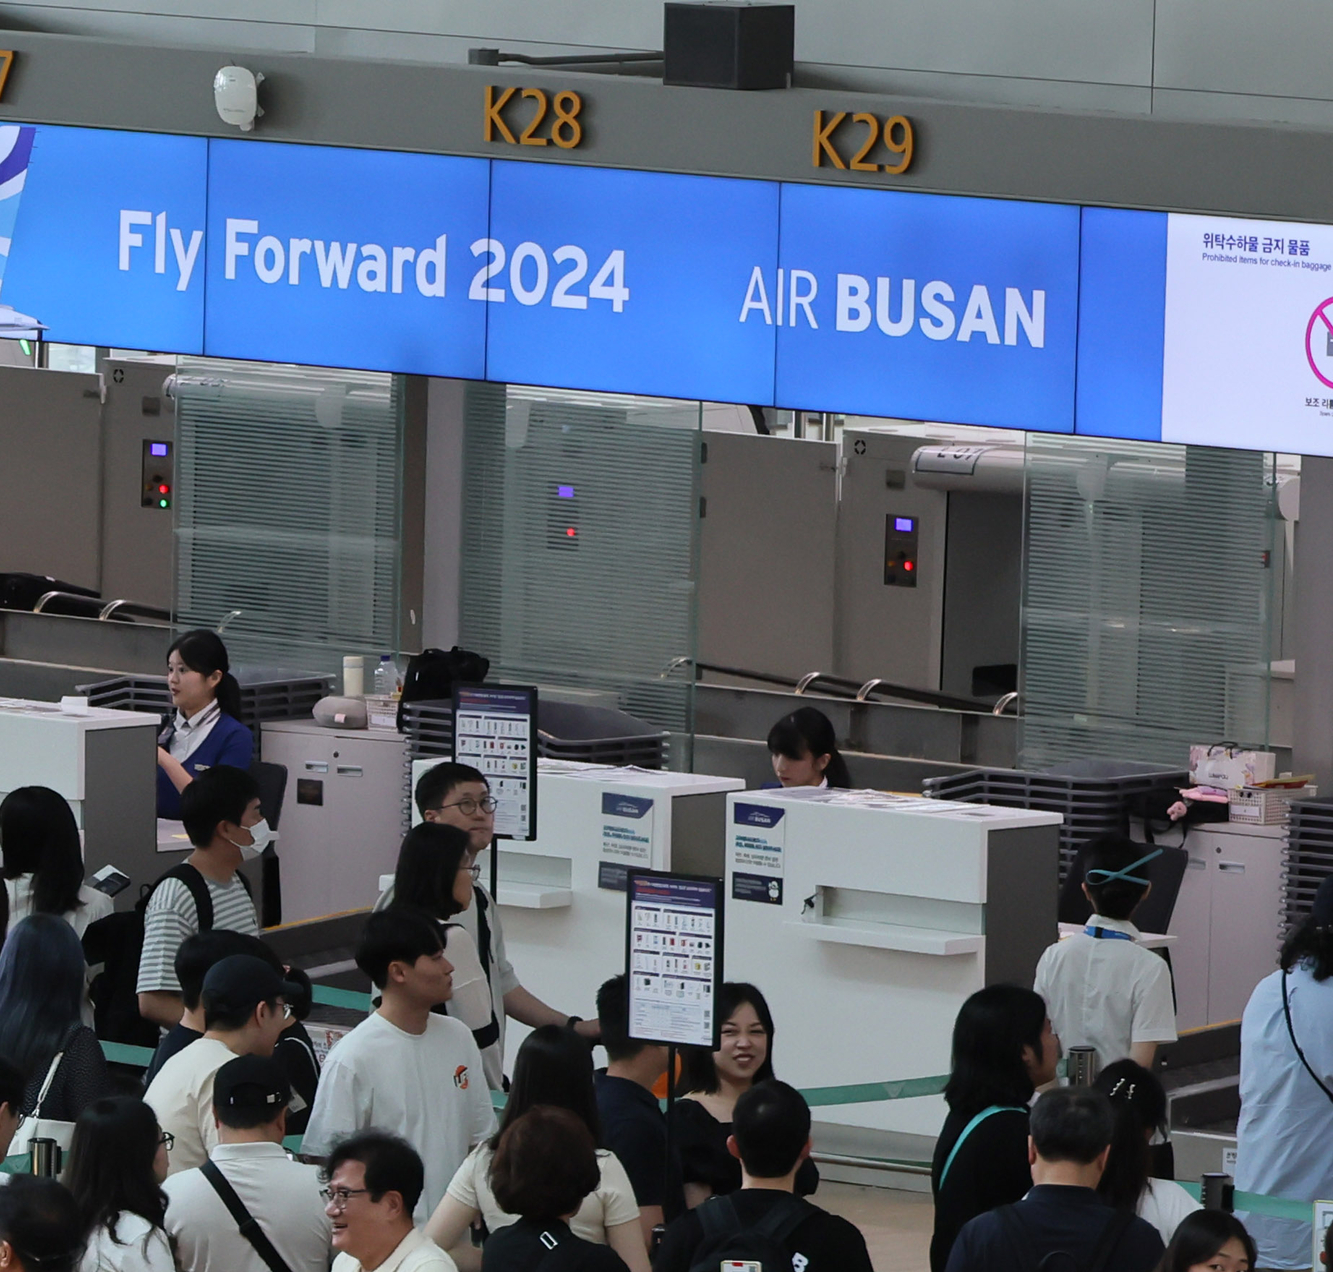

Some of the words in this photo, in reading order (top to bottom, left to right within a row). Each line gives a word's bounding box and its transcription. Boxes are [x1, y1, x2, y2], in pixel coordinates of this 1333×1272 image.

[483, 85, 583, 149] K28
[812, 109, 915, 175] K29
[119, 208, 205, 291] Fly
[225, 217, 447, 297] Forward
[469, 239, 630, 313] 2024
[1202, 253, 1238, 264] Prohibited
[1239, 255, 1258, 265] items
[1259, 257, 1269, 266] for
[1271, 258, 1300, 269] check-in
[1302, 260, 1332, 272] baggage
[1203, 233, 1259, 252] 위탁수하물
[1262, 237, 1285, 255] 금지
[1287, 240, 1311, 257] 물품
[739, 265, 819, 329] AIR
[835, 272, 1046, 349] BUSAN
